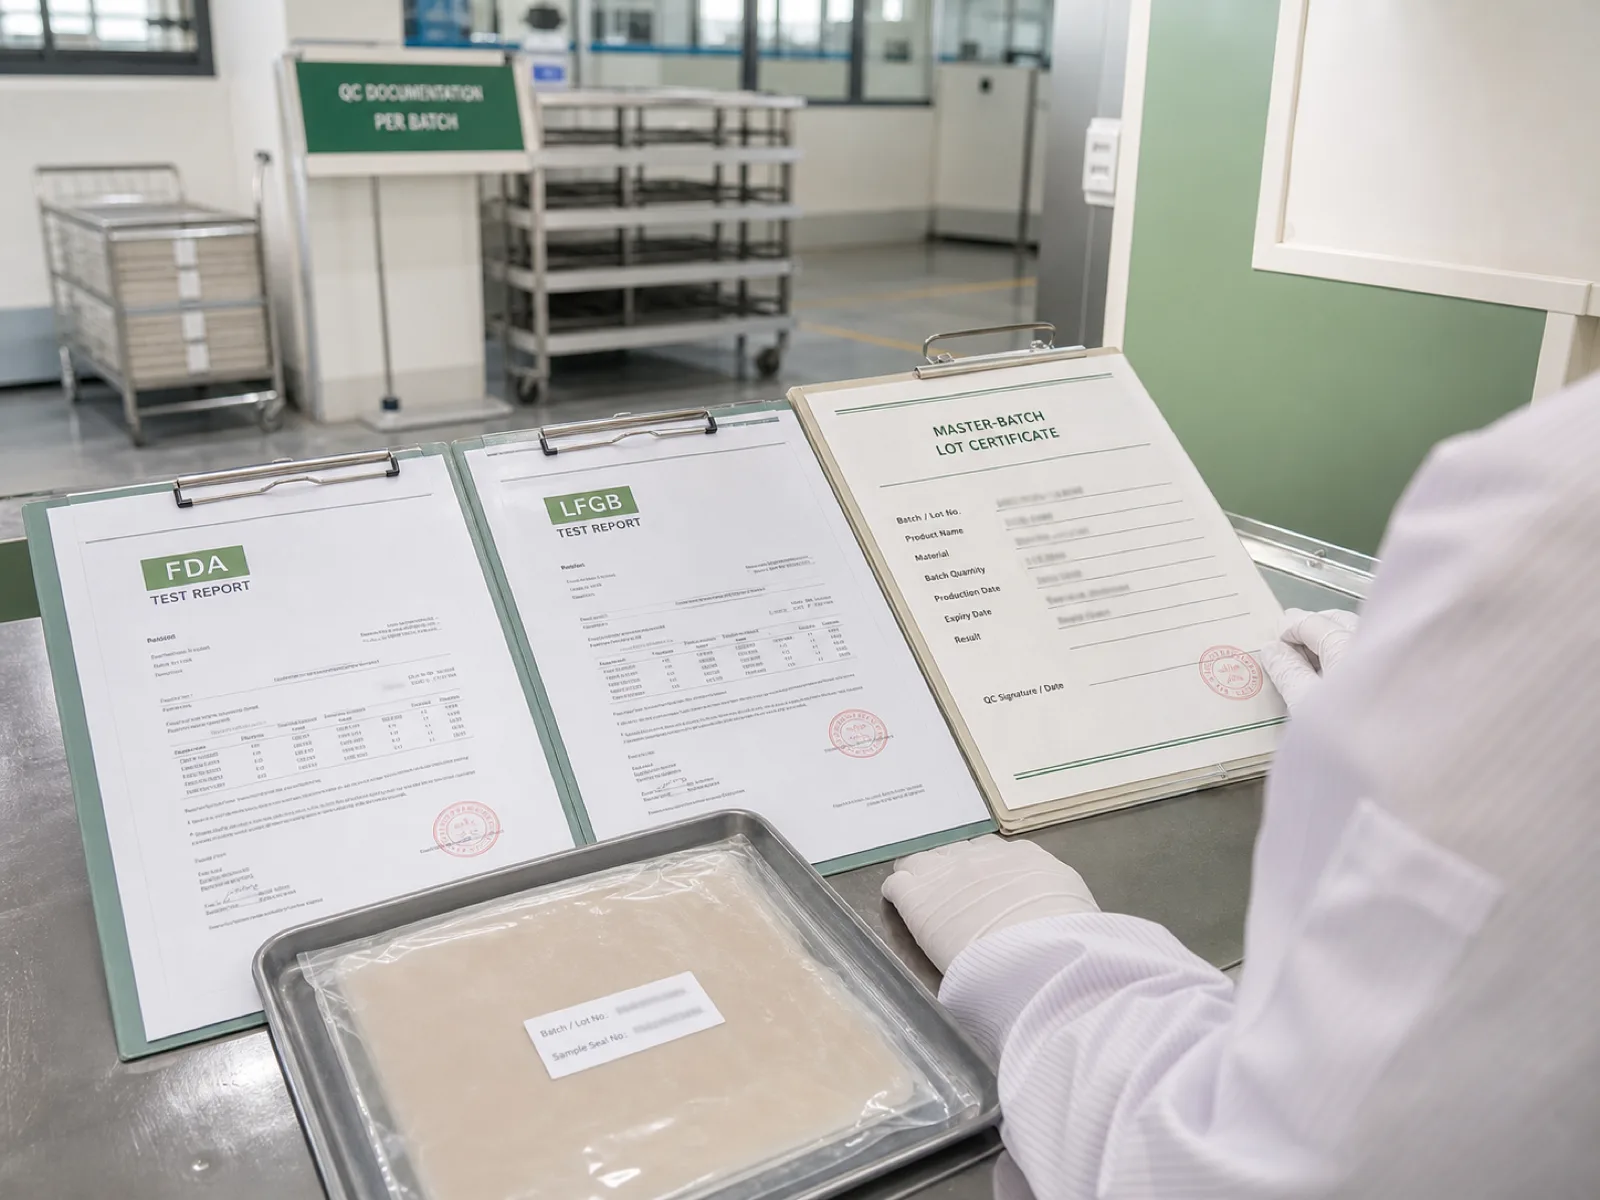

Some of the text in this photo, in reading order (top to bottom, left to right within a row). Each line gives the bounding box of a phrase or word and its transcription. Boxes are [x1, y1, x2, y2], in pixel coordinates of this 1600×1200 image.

[338, 83, 484, 103] QC DOCUMENTATION
[374, 112, 459, 131] PER BATCH
[933, 411, 1045, 437] MASTER-BATCH
[936, 427, 1060, 456] LOT CERTIFICATE
[560, 494, 622, 517] LFGB
[556, 517, 641, 538] TEST REPORT
[896, 515, 922, 525] Batch
[929, 511, 944, 519] Lot
[905, 528, 964, 543] Product Name
[914, 549, 950, 562] Material
[166, 555, 229, 581] FDA
[924, 571, 949, 582] Batch
[150, 580, 250, 605] TEST REPORT
[934, 585, 1001, 603] Production Date
[944, 608, 992, 623] Expiry Date
[954, 632, 982, 644] Result
[983, 694, 998, 705] QC
[998, 689, 1038, 702] Signature
[540, 1024, 568, 1038] Batch
[574, 1017, 591, 1028] Lot
[551, 1044, 588, 1061] Sample
[588, 1036, 609, 1049] Seal
